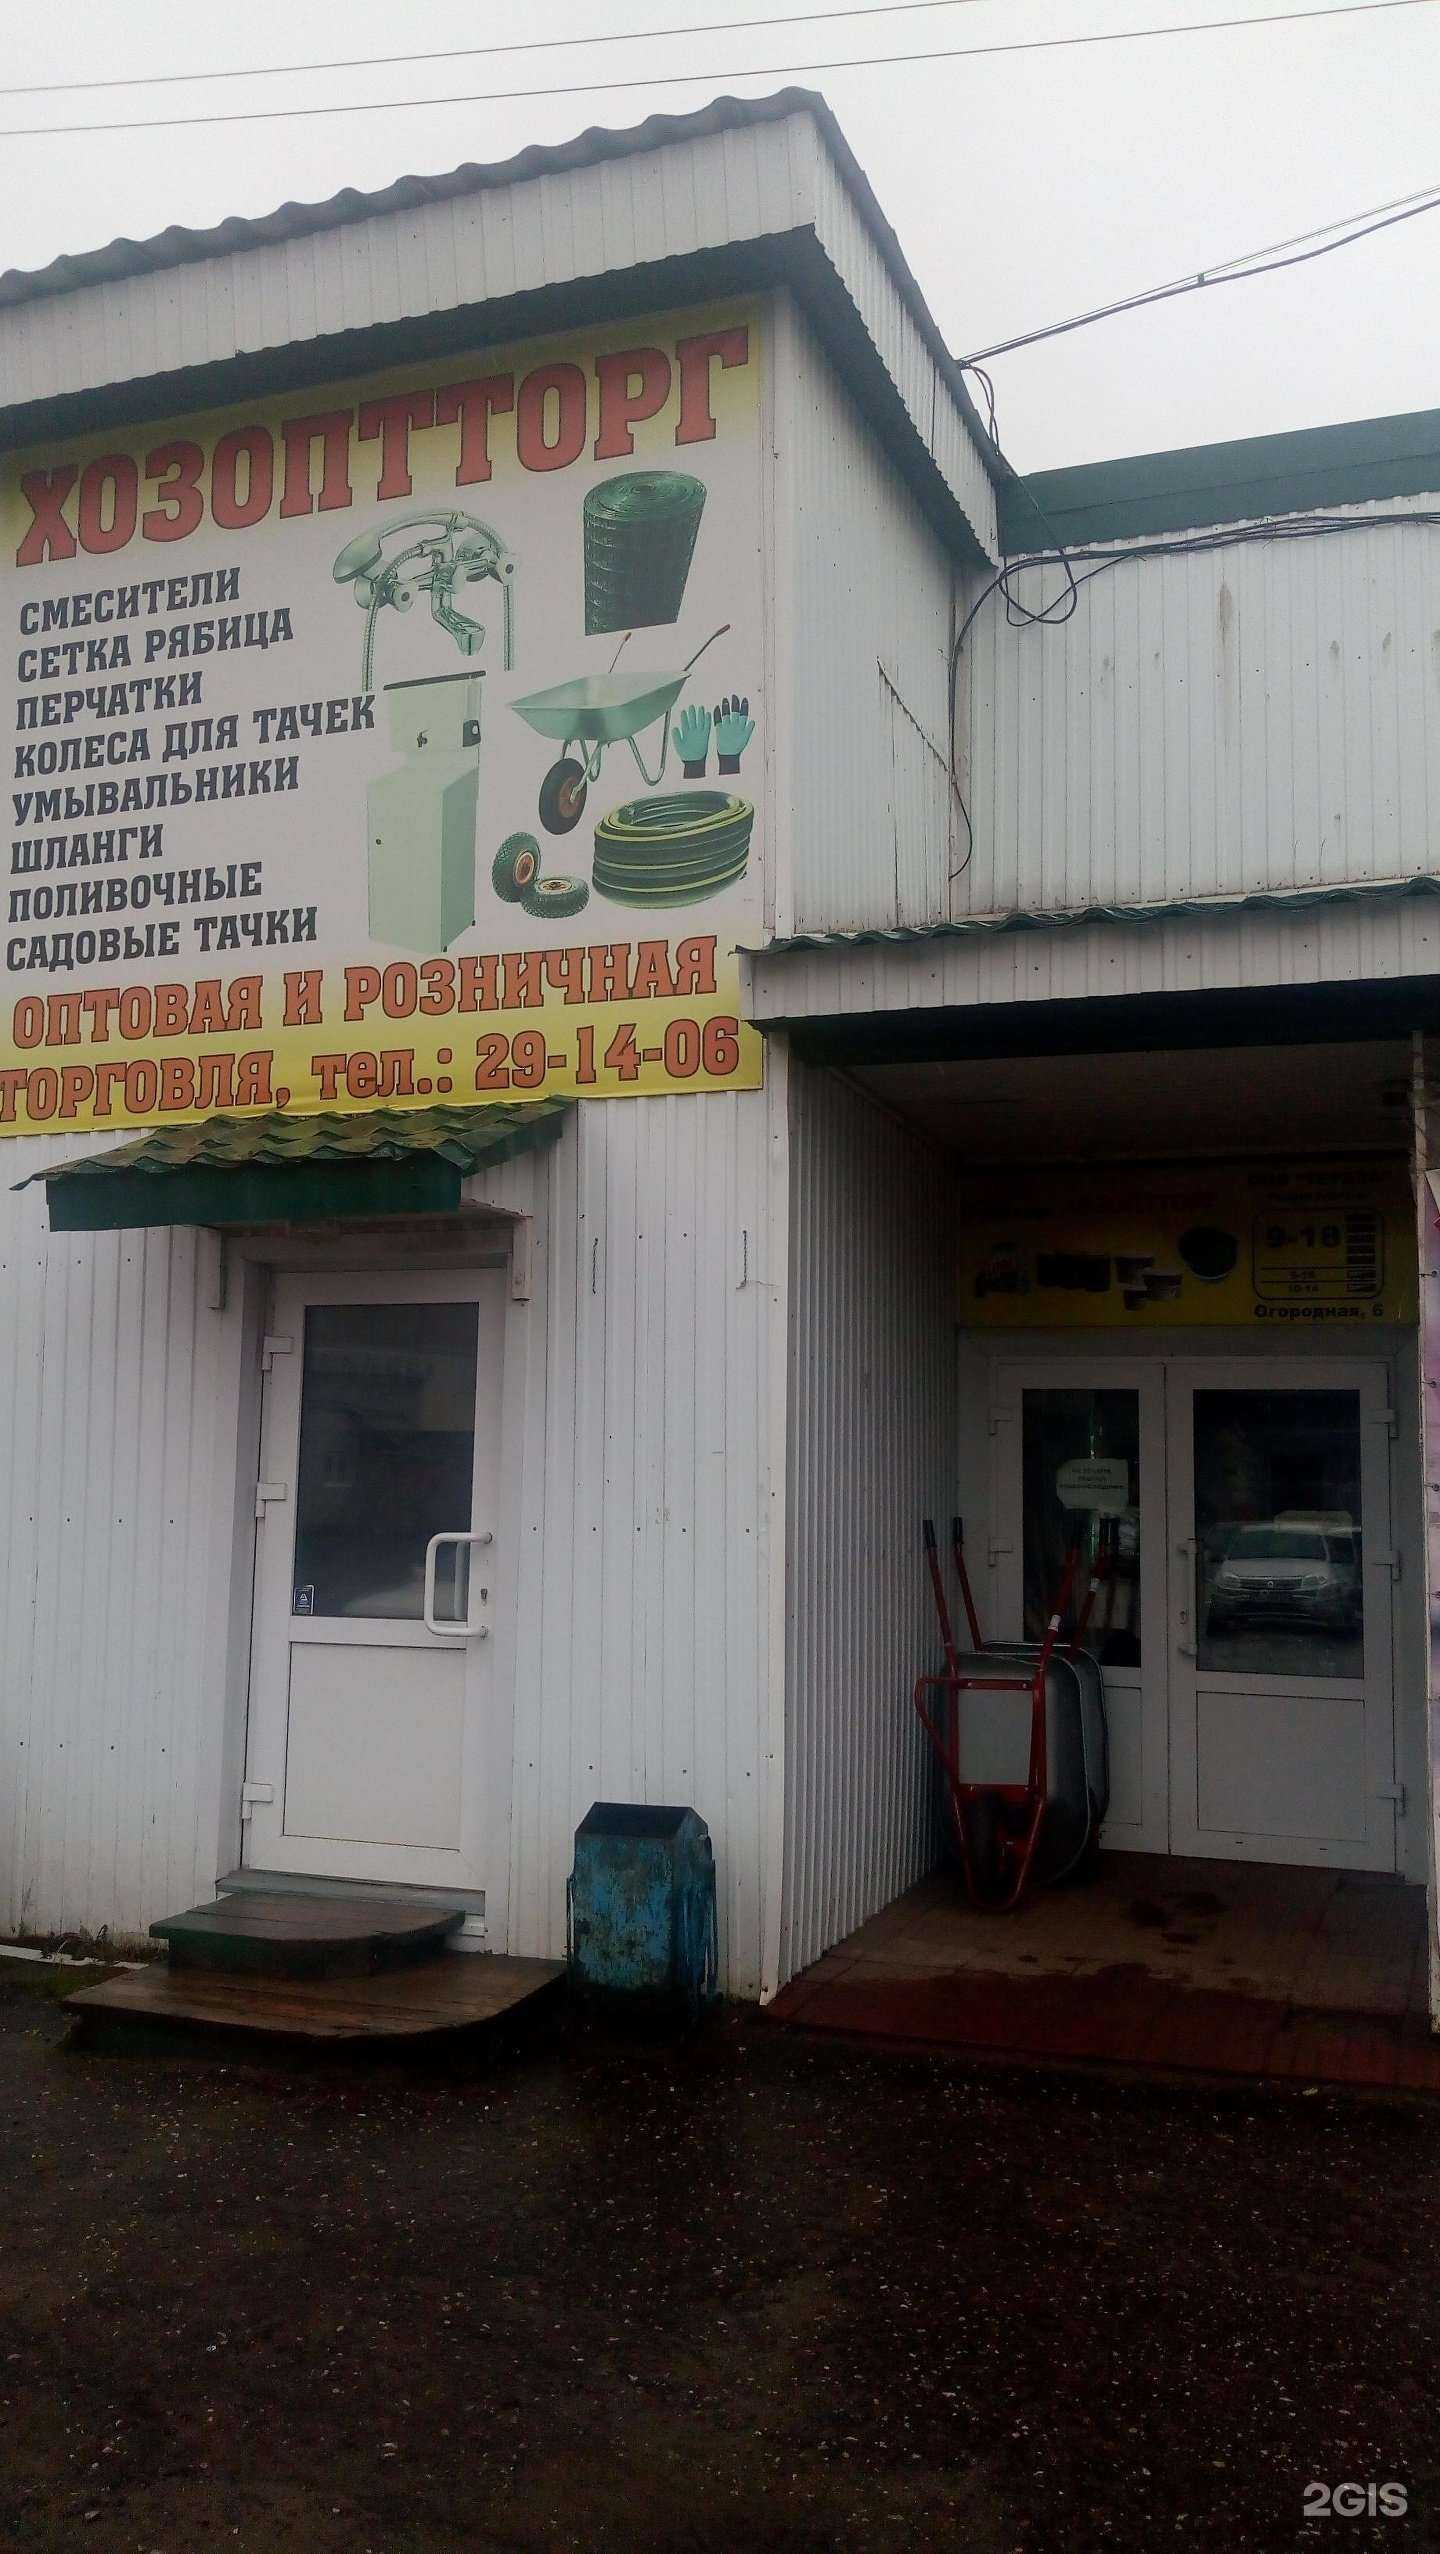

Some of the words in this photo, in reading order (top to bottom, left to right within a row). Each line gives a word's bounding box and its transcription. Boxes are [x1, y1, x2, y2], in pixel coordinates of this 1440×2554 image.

[16, 327, 749, 567] ХОЗОПТТОРГ
[20, 567, 241, 636] СМЕСИТЕЛИ
[17, 634, 132, 684] СЕТКА
[144, 607, 294, 664] РЯБИЦА
[16, 671, 203, 731] ПЕРЧАТКИ
[14, 728, 152, 779] КОЛЕСА
[161, 715, 239, 763] ДЛЯ
[252, 695, 376, 744] ТАЧЕК
[12, 756, 300, 826] УМЫВАЛЬНИКИ
[10, 823, 164, 875] ШЛАНГИ
[8, 862, 262, 923] ПОЛИВОЧНЫЕ
[6, 920, 181, 973] САДОВЫЕ
[193, 906, 318, 952] ТАЧКИ
[13, 975, 264, 1049] ОПТОВАЯ
[283, 969, 324, 1026] И
[344, 935, 717, 1021] РОЗНИЧНАЯ
[0, 1051, 291, 1122] ТОРГОВЛЯ,
[311, 1047, 454, 1100] тел.:
[475, 1016, 740, 1091] 29-14-06
